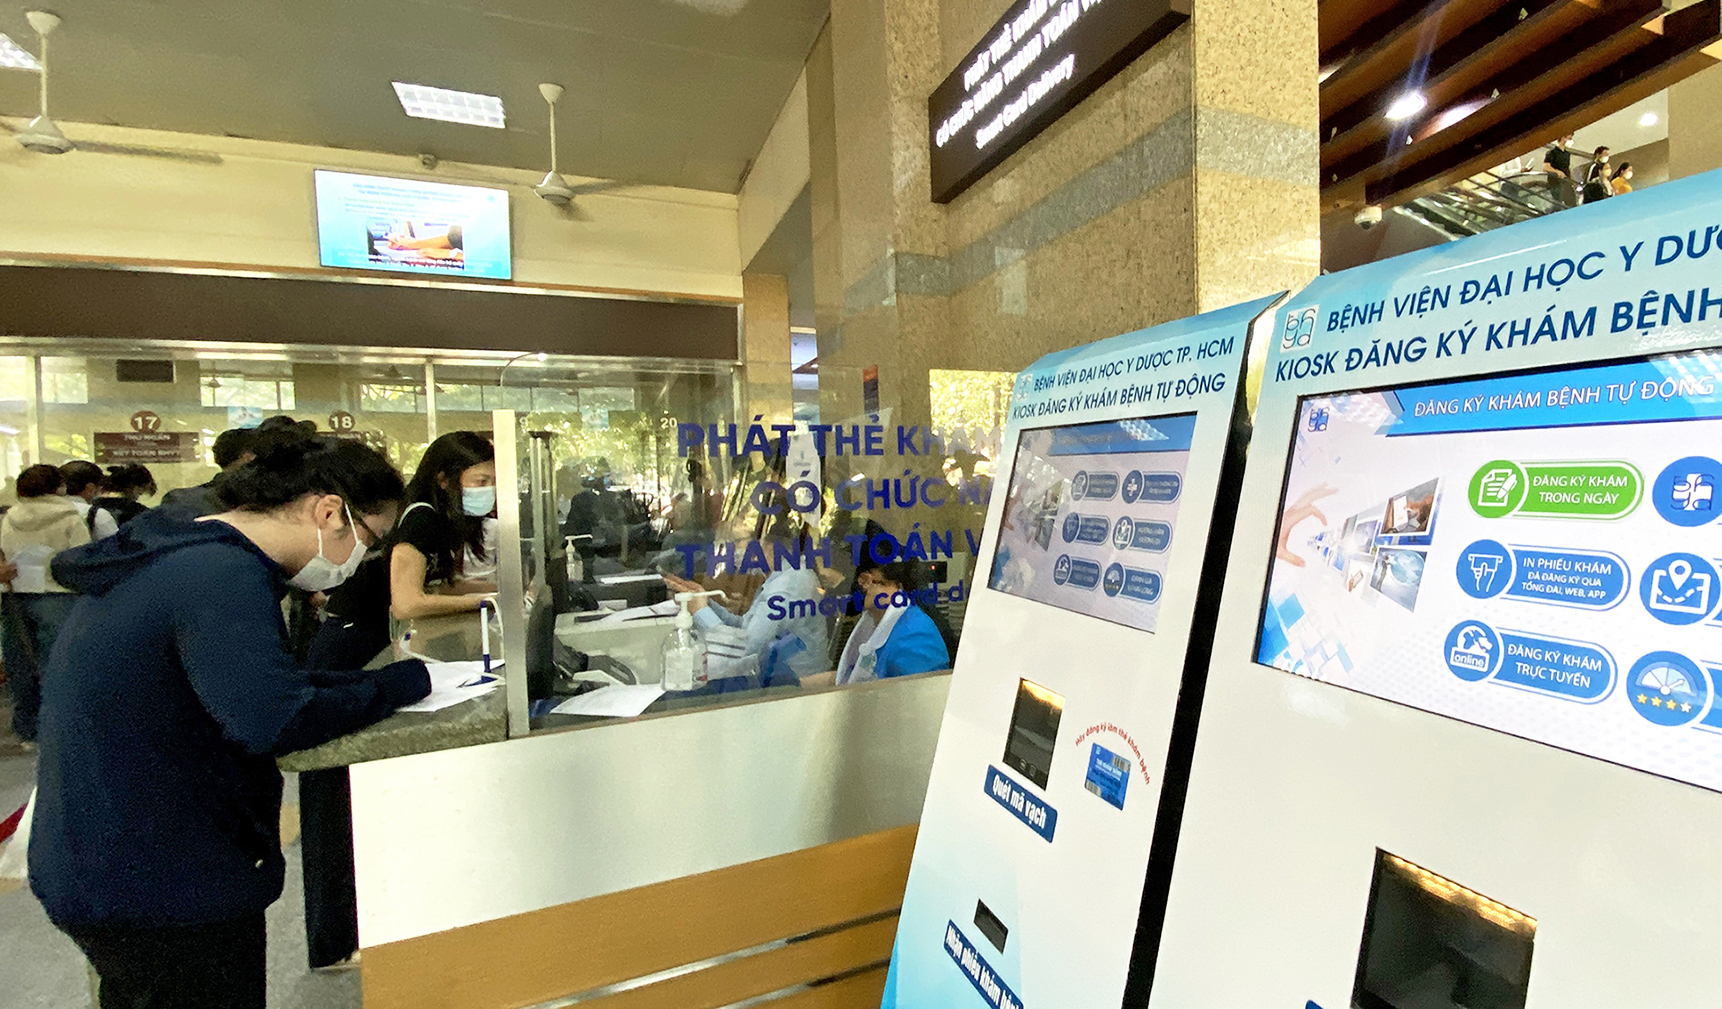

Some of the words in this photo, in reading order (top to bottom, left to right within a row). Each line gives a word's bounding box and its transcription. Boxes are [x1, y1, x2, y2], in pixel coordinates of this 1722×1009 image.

[1326, 300, 1385, 334] BỆNH
[1393, 284, 1452, 319] VIỆN
[1459, 270, 1514, 305] ĐẠI
[1522, 251, 1606, 292] HỌC
[1619, 241, 1645, 272] Y
[1655, 224, 1722, 267] DƯ
[1275, 350, 1339, 383] KIOSK
[1345, 336, 1428, 372] ĐĂNG
[1435, 319, 1478, 359] KÝ
[1485, 303, 1598, 351] KHÁM
[1610, 287, 1722, 336] BỆNH
[1033, 374, 1056, 393] BỆNH
[1057, 369, 1078, 388] VIỆN
[1079, 366, 1097, 384] ĐẠI
[1098, 360, 1124, 380] HỌC
[1126, 357, 1135, 374] Y
[1135, 349, 1174, 372] DƯỢC
[1176, 346, 1192, 364] TP.
[1197, 336, 1235, 360] HCM
[1012, 403, 1037, 420] KIOSK
[1038, 398, 1067, 417] ĐĂNG
[1068, 391, 1083, 412] KÝ
[1084, 386, 1118, 410] KHÁM
[1120, 384, 1153, 407] BỆNH
[1157, 380, 1174, 403] TỰ
[1175, 372, 1226, 400] ĐỘNG
[1414, 399, 1459, 417] ĐĂNG
[1463, 393, 1486, 413] KÝ
[1487, 389, 1542, 412] KHÁM
[1546, 385, 1601, 409] BỆNH
[1605, 380, 1637, 405] TỰ
[1640, 375, 1715, 402] ĐỘNG
[133, 416, 158, 430] 17
[331, 415, 353, 429] 18
[660, 417, 678, 429] 20
[677, 414, 796, 458] PHÁT
[808, 414, 884, 457] THẺ
[750, 470, 821, 516] CÓ
[834, 469, 947, 511] CHỨC
[1532, 474, 1568, 487] ĐĂNG
[1570, 475, 1586, 487] KÝ
[1588, 474, 1628, 487] KHÁM
[1539, 491, 1580, 504] TRONG
[1583, 491, 1620, 505] NGÀY
[675, 536, 831, 580] THANH
[844, 522, 953, 567] TOÁN
[1523, 557, 1535, 568] IN
[1537, 557, 1572, 571] PHIẾU
[1574, 561, 1612, 575] KHÁM
[1522, 580, 1545, 593] TỔNG
[1565, 587, 1586, 598] WEB,
[1587, 590, 1606, 599] APP
[1541, 571, 1567, 584] ĐĂNG
[1568, 575, 1580, 584] KÝ
[1581, 577, 1602, 587] QUA
[767, 589, 866, 621] Smart
[873, 580, 938, 610] card
[948, 579, 969, 603] d
[1454, 651, 1485, 668] online
[1507, 643, 1543, 661] ĐĂNG
[1544, 650, 1561, 664] KÝ
[1562, 655, 1602, 672] KHÁM
[1515, 662, 1547, 680] TRỰC
[1548, 668, 1591, 689] TUYẾN
[992, 774, 1012, 803] Quét
[1010, 789, 1025, 813] mã
[1024, 800, 1047, 830] vạch
[945, 925, 963, 959] Nhận
[961, 946, 982, 981] phiếu
[980, 965, 1001, 1006] khám
